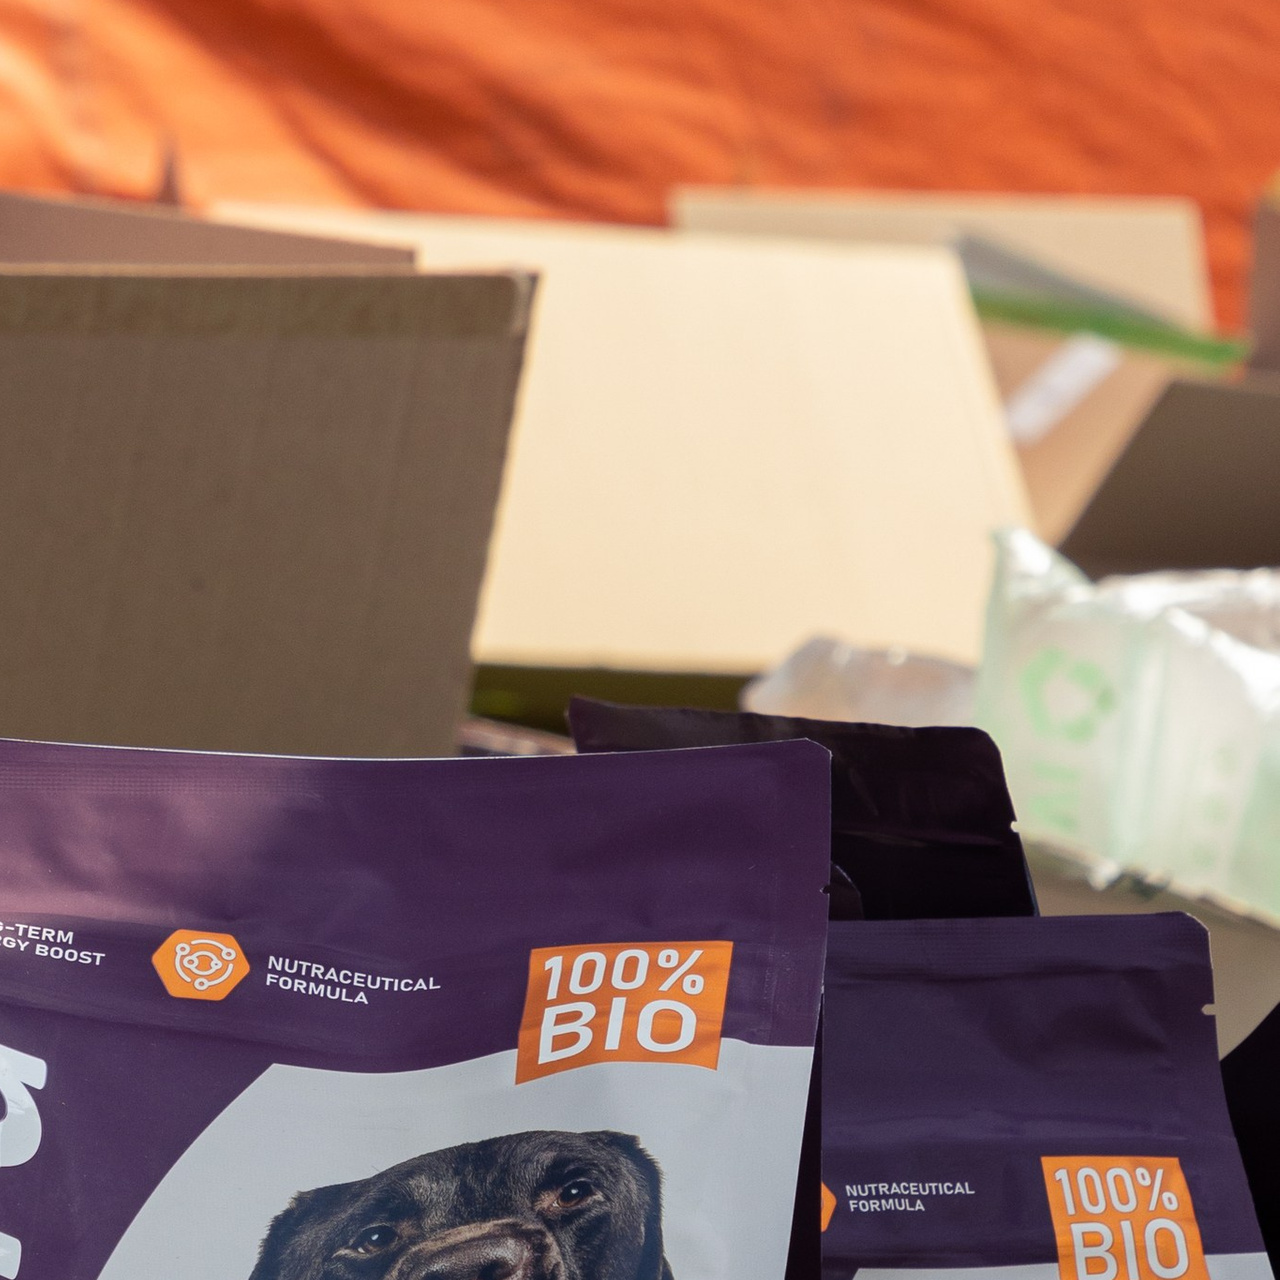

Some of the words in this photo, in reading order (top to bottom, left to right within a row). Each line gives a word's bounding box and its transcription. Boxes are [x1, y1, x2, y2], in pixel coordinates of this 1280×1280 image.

[35, 944, 106, 966] BOOST
[265, 973, 369, 1004] FORMULA
[267, 955, 441, 992] NUTRACEUTICAL
[544, 948, 705, 1001] 100%
[538, 998, 697, 1065] BIO
[846, 1181, 975, 1197] NUTRACEUTICAL
[849, 1198, 925, 1213] FORMULA
[1055, 1166, 1178, 1215] 100%
